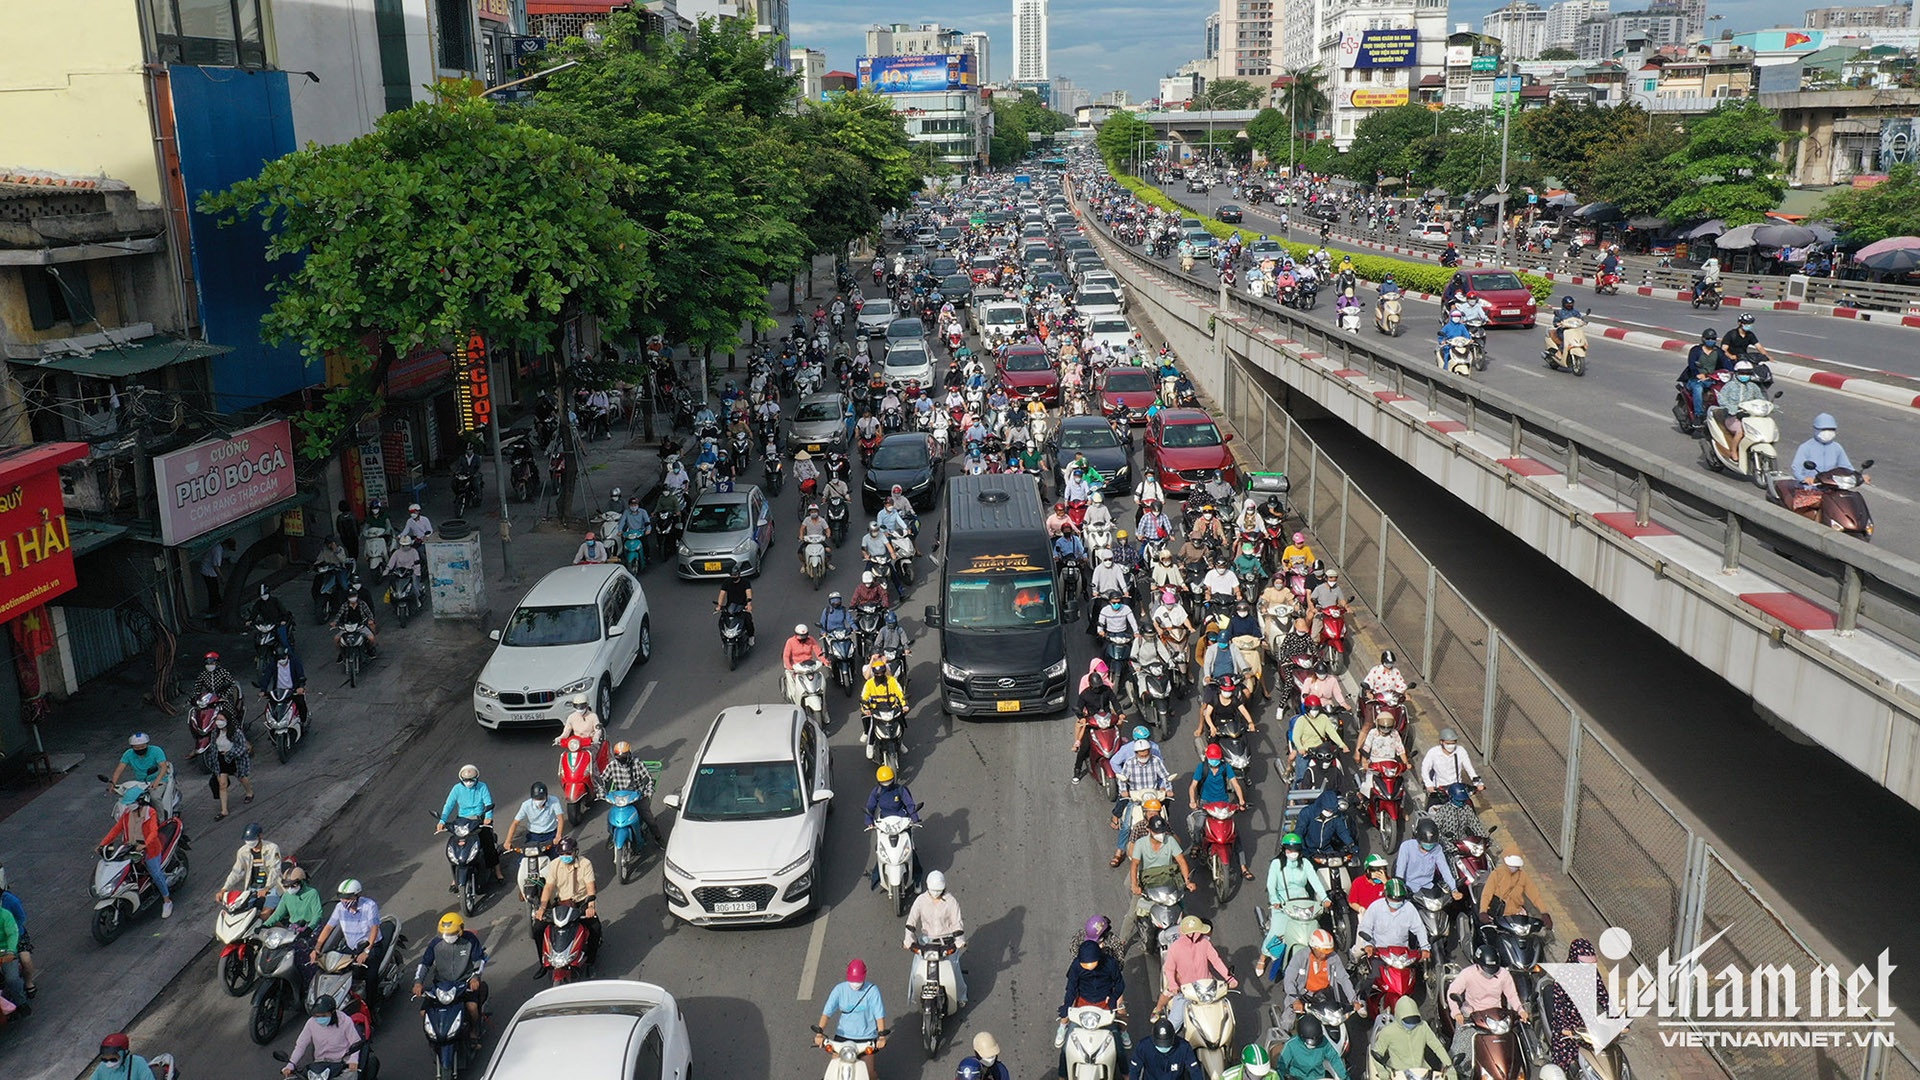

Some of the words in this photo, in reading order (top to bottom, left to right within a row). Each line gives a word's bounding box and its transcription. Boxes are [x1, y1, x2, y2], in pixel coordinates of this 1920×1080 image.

[175, 466, 222, 508] PHỞ
[224, 443, 287, 490] BÒ-GÀ
[213, 494, 237, 511] RANG
[17, 507, 71, 568] HẢI
[0, 579, 60, 613] aotinmanhhai.vn
